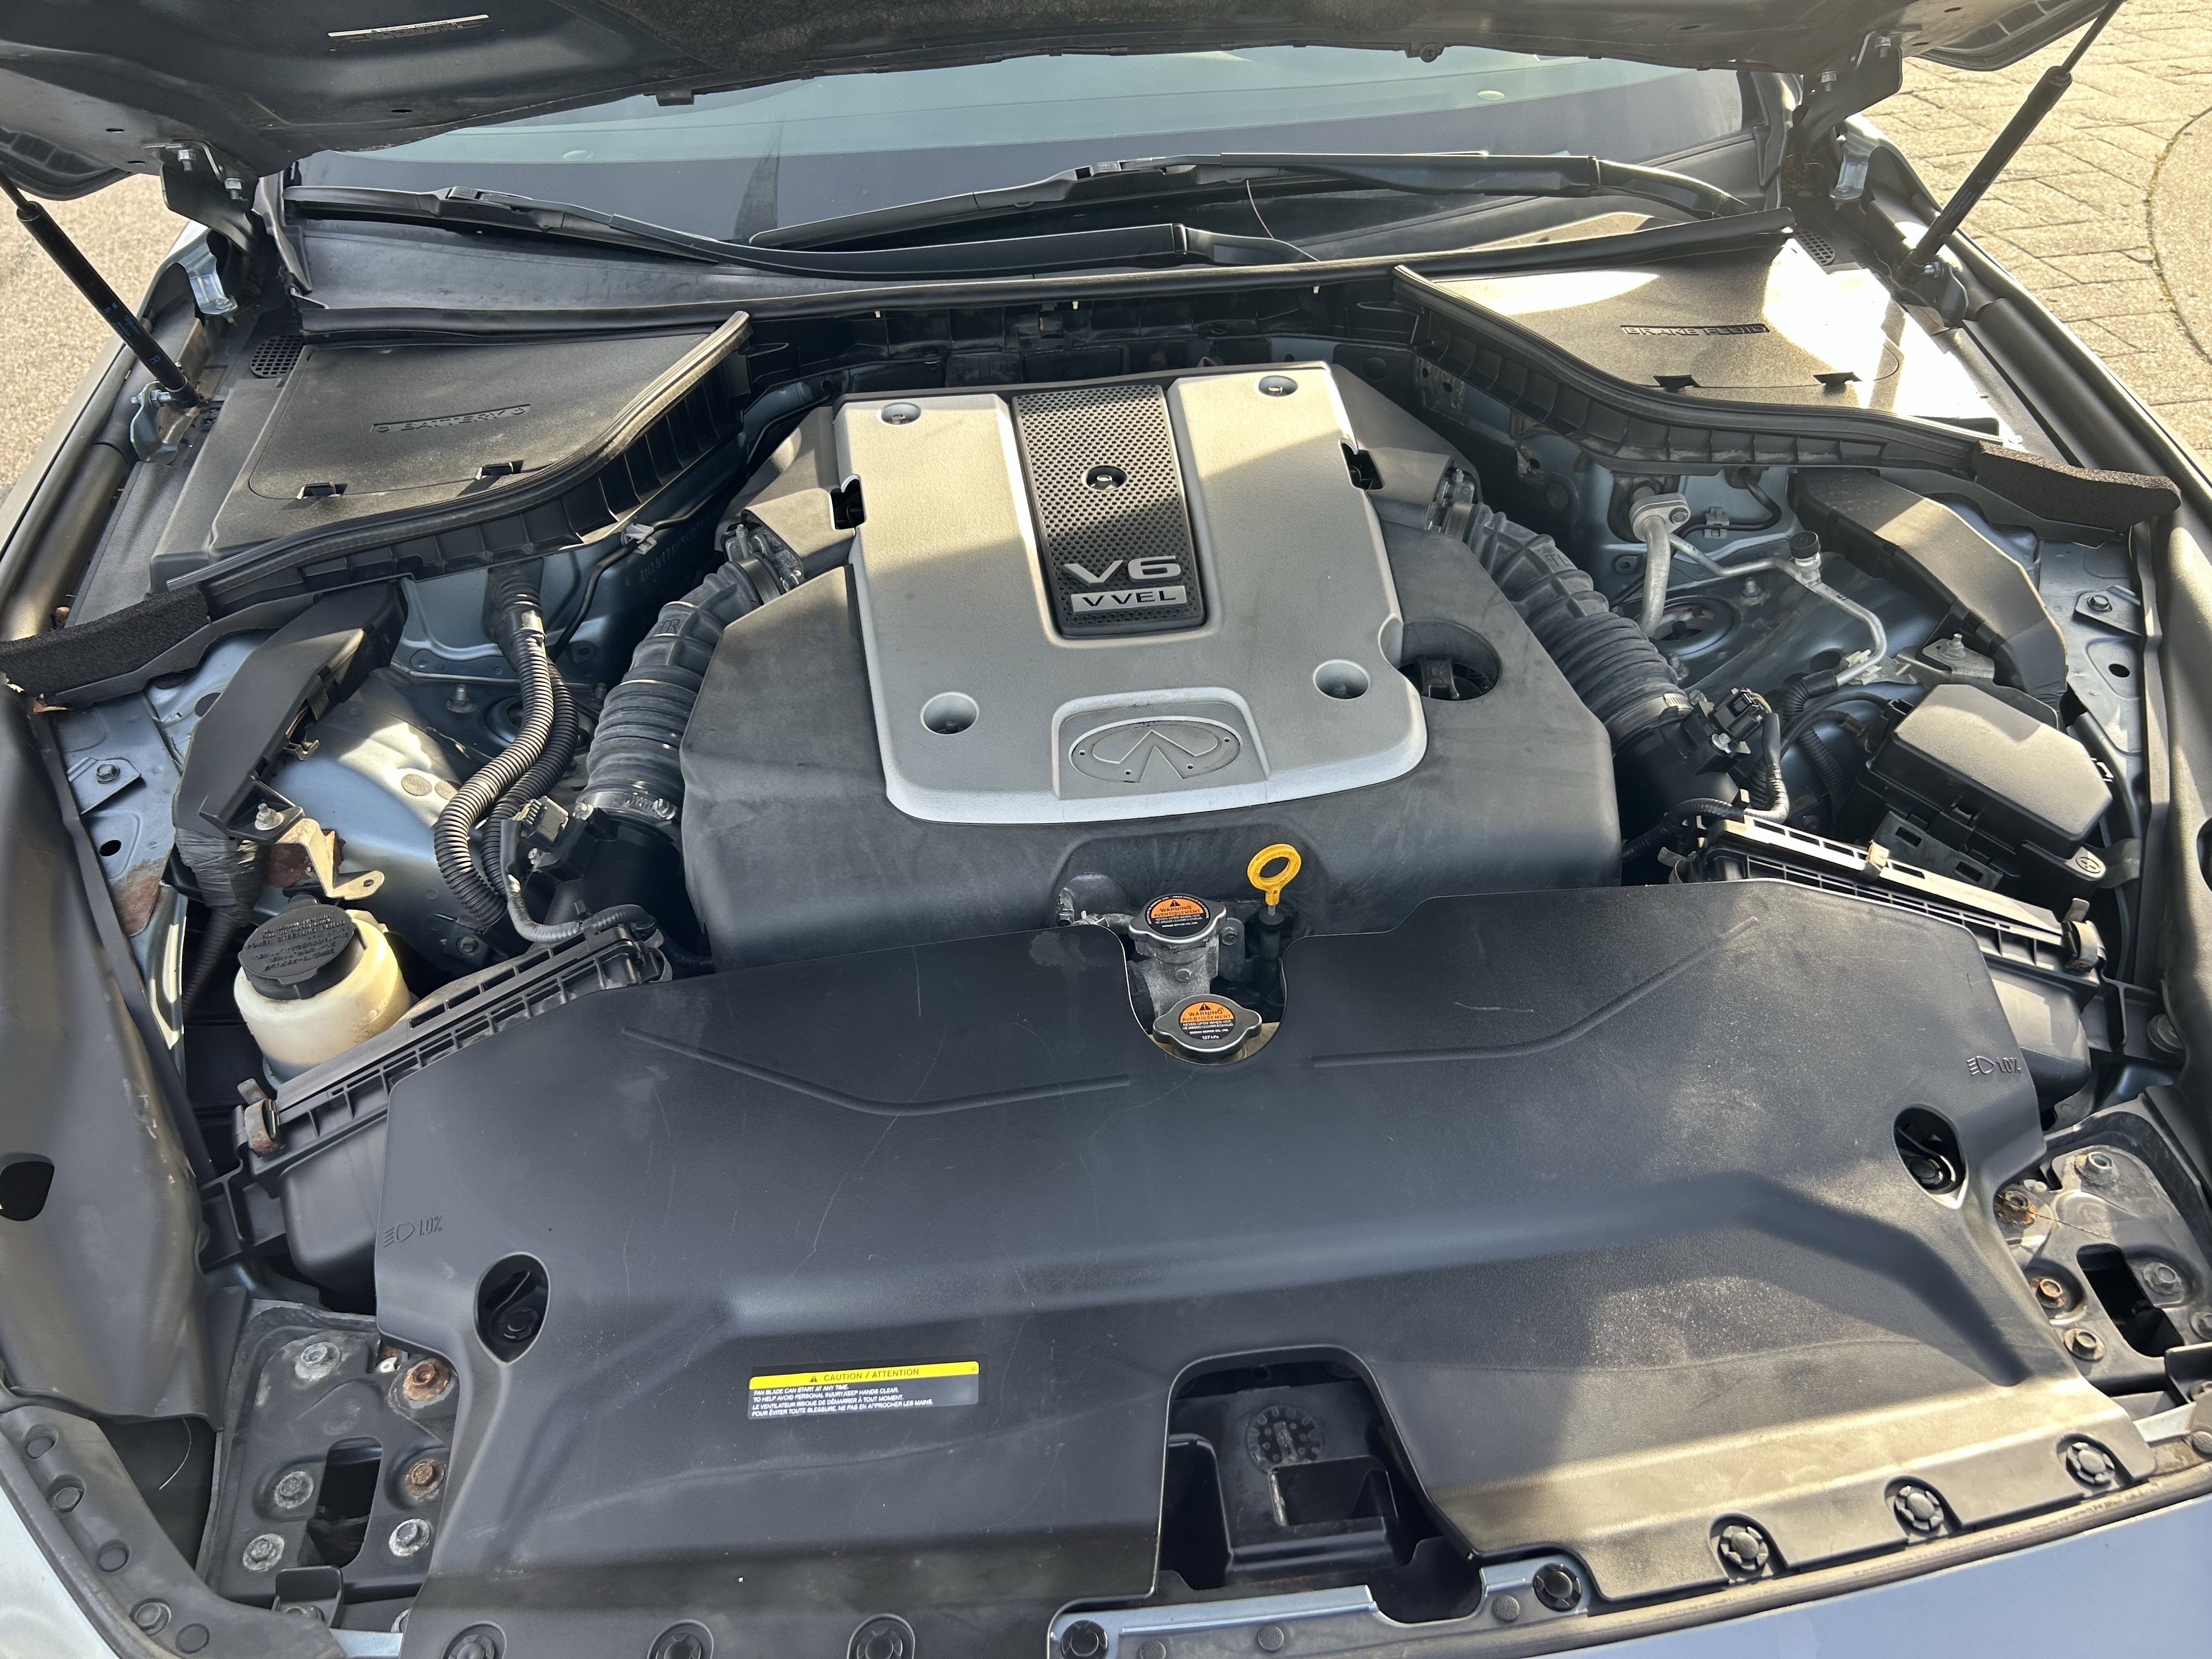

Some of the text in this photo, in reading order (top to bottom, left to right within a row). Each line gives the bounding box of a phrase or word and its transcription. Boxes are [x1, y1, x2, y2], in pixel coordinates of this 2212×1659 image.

[1623, 326, 1770, 336] BRAKE FLUID
[400, 409, 505, 431] BATTERY
[1063, 555, 1181, 585] V6
[1082, 590, 1177, 607] VVEL
[659, 619, 680, 633] TR
[1154, 909, 1200, 917] AVERTISSEMENT
[823, 1373, 862, 1381] CAUTION
[872, 1368, 919, 1378] ATTENTION
[827, 1397, 857, 1406] DÉMARRER
